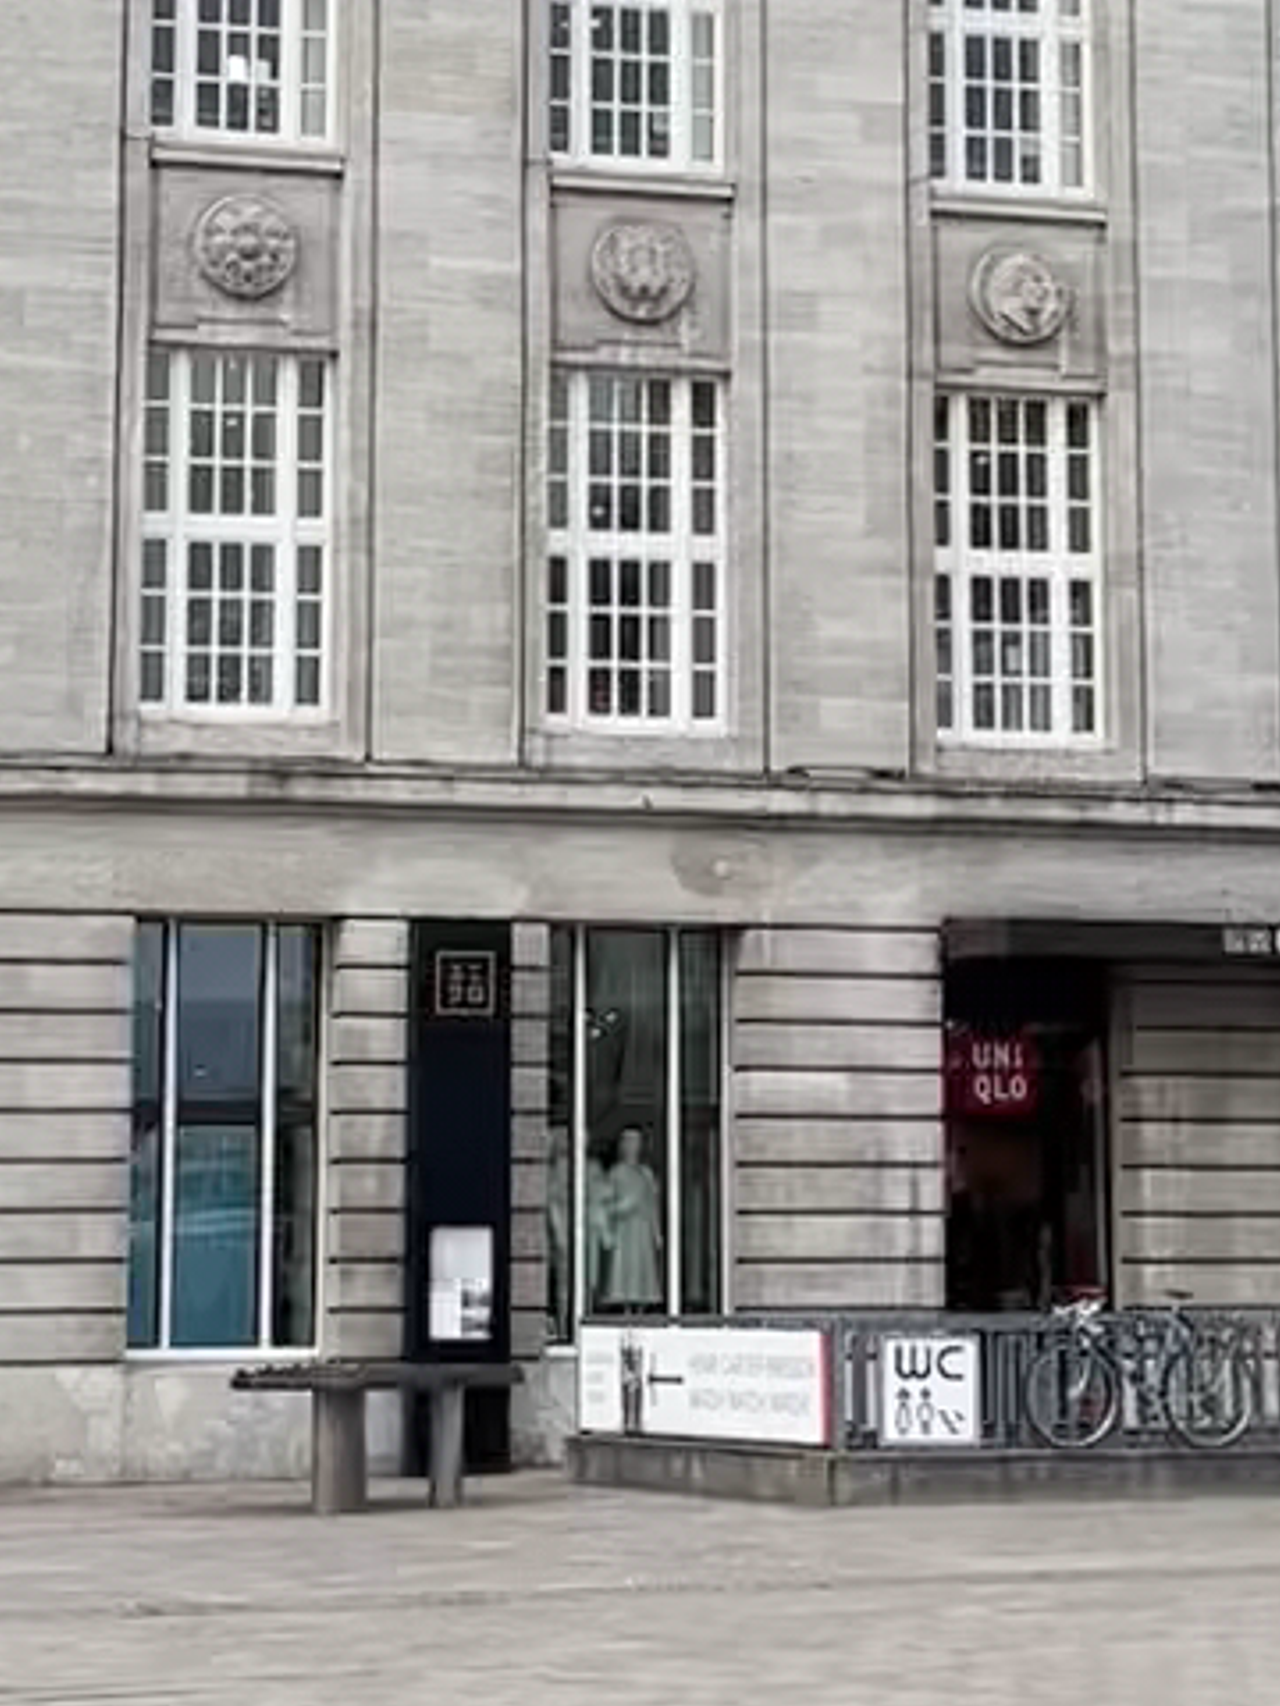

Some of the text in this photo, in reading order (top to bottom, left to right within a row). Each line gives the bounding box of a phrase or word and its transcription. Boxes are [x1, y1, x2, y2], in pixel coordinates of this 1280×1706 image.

[972, 1043, 1023, 1069] UNI
[973, 1075, 1027, 1105] QLO
[893, 1345, 966, 1381] WC
